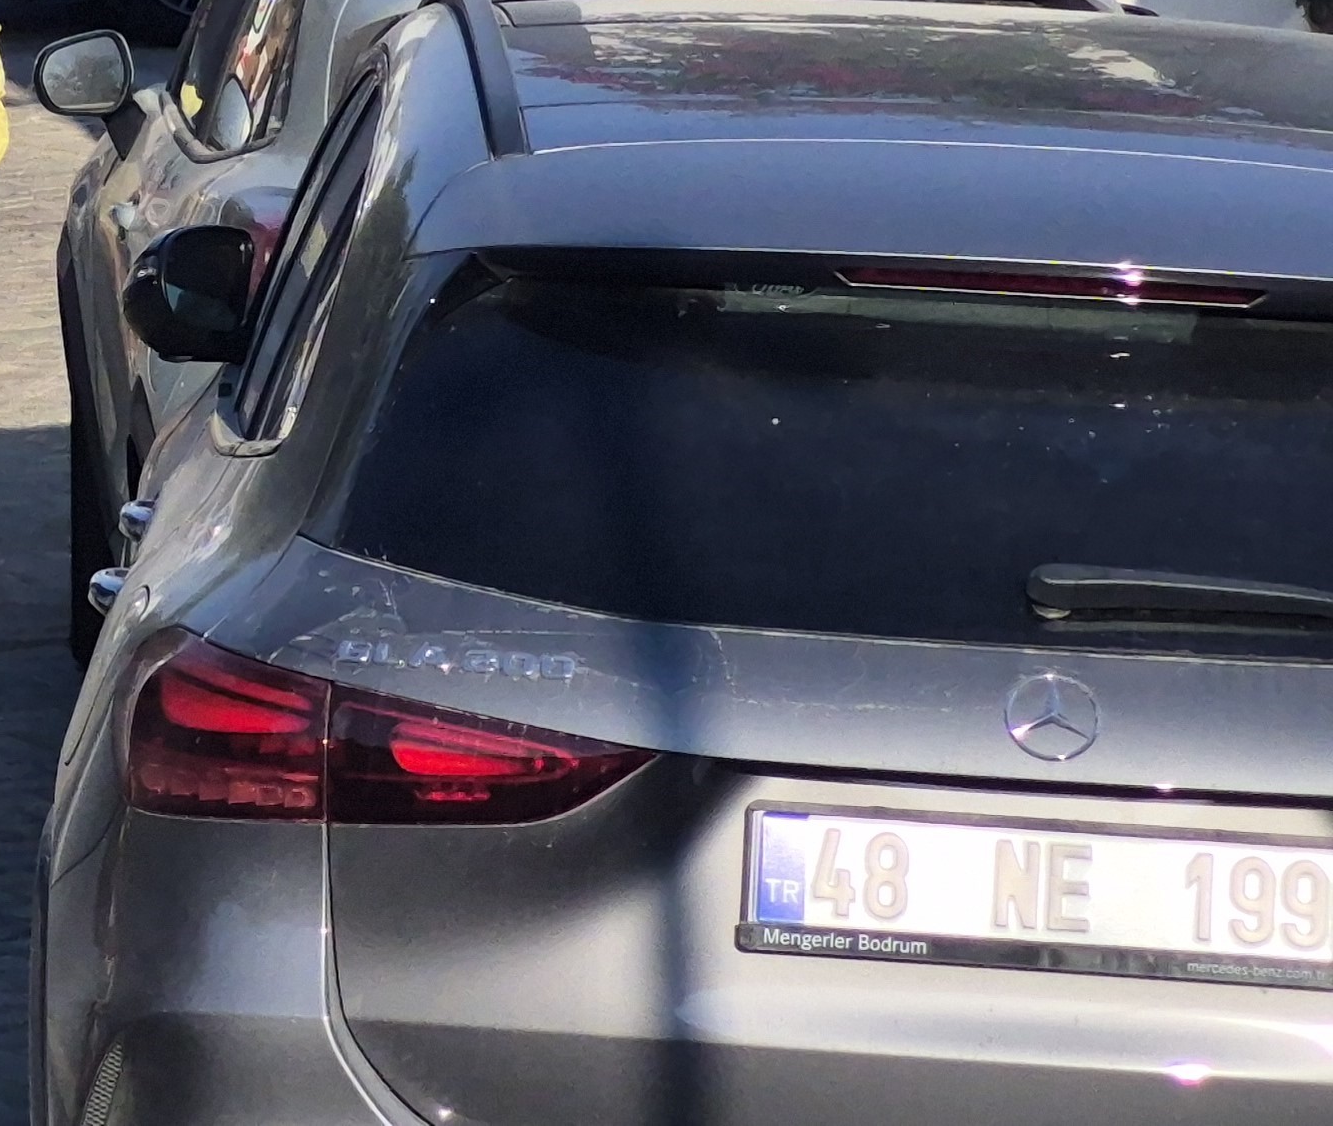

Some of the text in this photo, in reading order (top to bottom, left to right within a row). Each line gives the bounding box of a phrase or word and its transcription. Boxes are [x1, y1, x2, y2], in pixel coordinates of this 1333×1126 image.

[764, 878, 799, 904] TR
[812, 828, 1329, 947] 48 NE 199
[763, 928, 927, 955] Mengerler Bodrum
